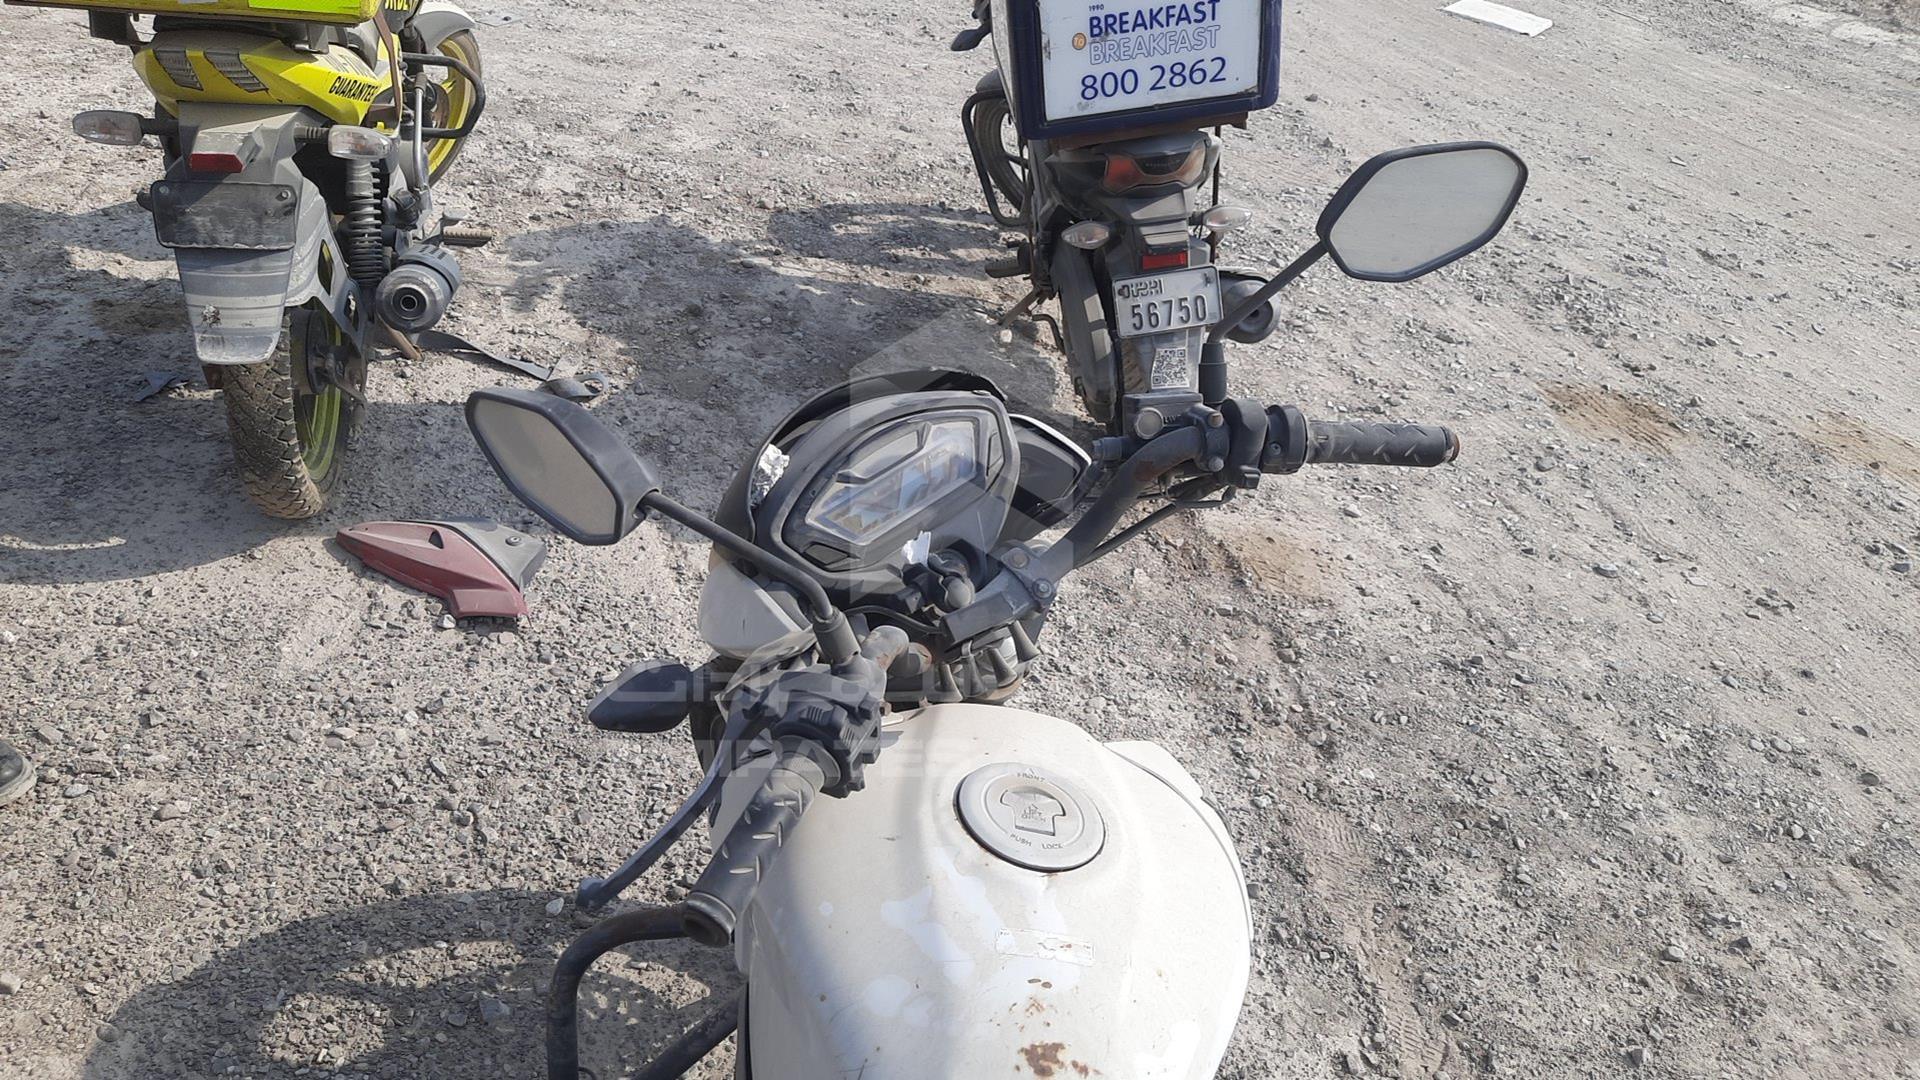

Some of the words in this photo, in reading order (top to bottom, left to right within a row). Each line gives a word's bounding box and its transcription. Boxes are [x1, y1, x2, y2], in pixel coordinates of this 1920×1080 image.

[1089, 0, 1221, 38] BREAKFAST
[1090, 25, 1221, 65] BREAKFAST
[1080, 69, 1139, 100] 800
[1149, 56, 1227, 91] 2862
[1131, 294, 1208, 331] 56750
